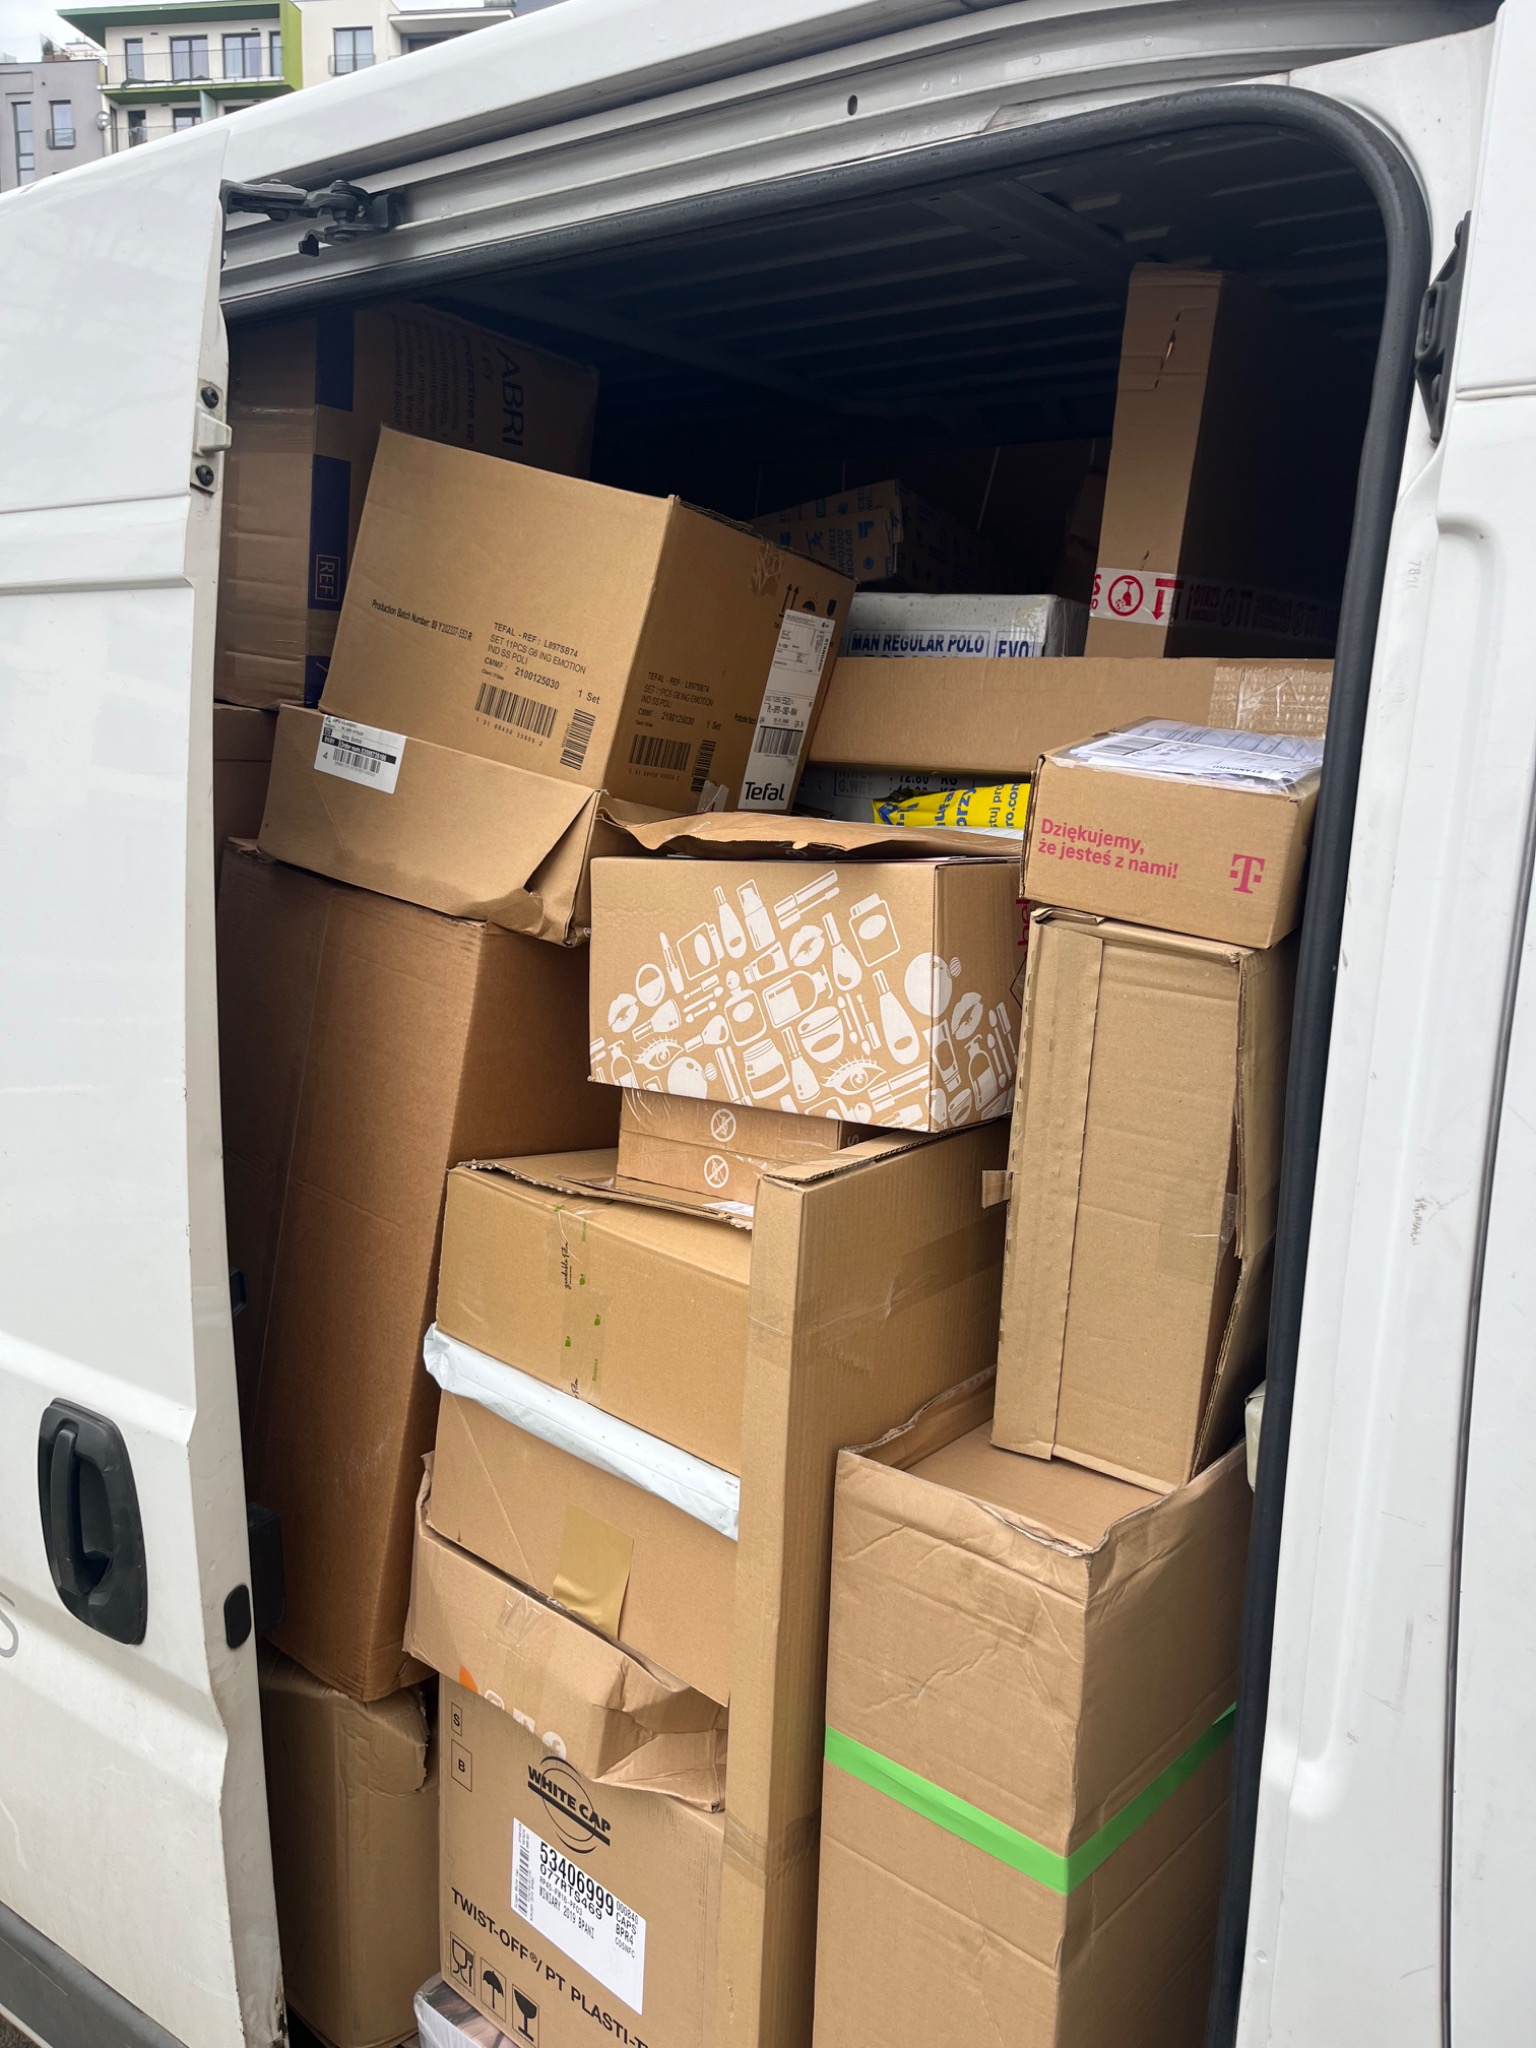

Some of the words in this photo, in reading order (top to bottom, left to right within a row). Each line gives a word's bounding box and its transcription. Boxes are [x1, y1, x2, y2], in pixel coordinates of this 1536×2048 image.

[318, 561, 335, 598] REF
[494, 622, 515, 636] TEFAL
[489, 634, 505, 645] SET
[506, 639, 528, 654] 11PCS
[553, 656, 587, 674] EMOTION
[851, 633, 879, 651] MAN
[883, 633, 944, 652] REGULAR
[948, 634, 985, 653] POLO
[515, 667, 560, 690] 2100125030
[586, 692, 600, 704] Set
[745, 781, 785, 801] Tefal
[1040, 818, 1145, 856] Dziękujemy,
[1038, 837, 1057, 855] że
[1058, 842, 1111, 866] jesteś
[1115, 855, 1125, 868] z
[1128, 857, 1179, 879] nami!
[1229, 853, 1266, 894] T
[453, 1714, 461, 1726] S
[458, 1759, 466, 1772] B
[527, 1764, 577, 1811] WHITE
[579, 1804, 611, 1832] CAP
[540, 1841, 614, 1917] 53406999
[540, 1863, 602, 1920] 077RTS469
[563, 1905, 576, 1924] 2019
[616, 1912, 637, 1935] CAPS
[545, 1964, 566, 1991] PT
